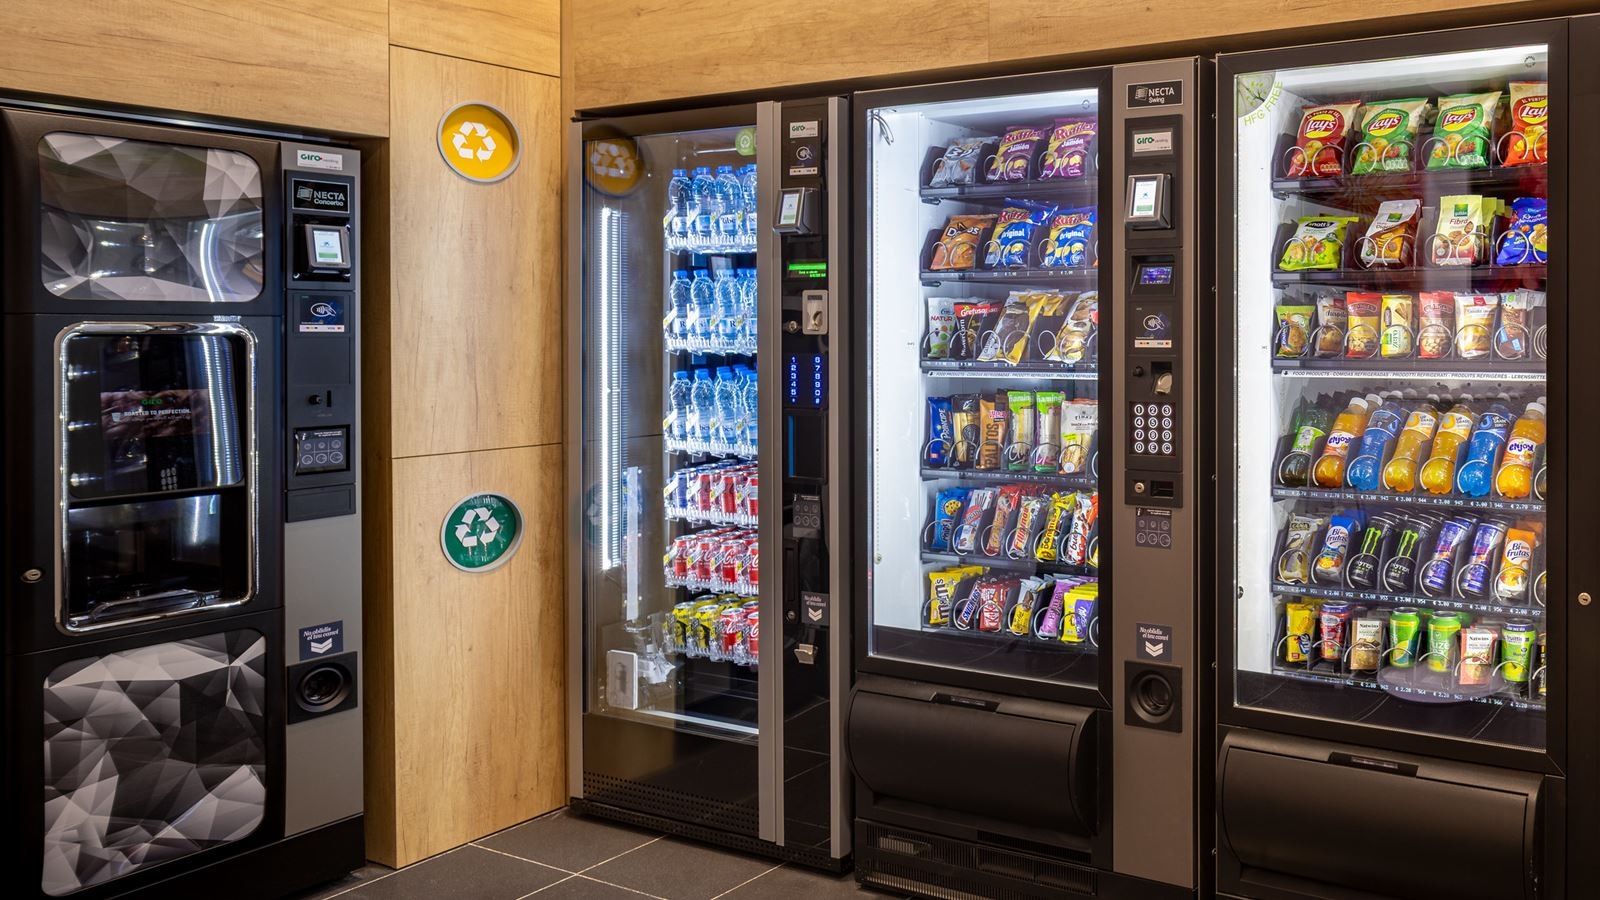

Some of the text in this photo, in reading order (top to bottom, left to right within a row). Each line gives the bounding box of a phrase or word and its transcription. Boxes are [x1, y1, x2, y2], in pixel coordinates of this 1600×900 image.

[1148, 86, 1175, 97] NECTA
[1264, 81, 1283, 113] FREE
[1148, 96, 1165, 104] Swing
[1055, 121, 1096, 140] Ruffles
[313, 191, 345, 201] NECTA
[1508, 442, 1534, 452] enjoy
[1512, 542, 1522, 551] Bi
[1506, 549, 1531, 560] frutas
[962, 587, 981, 621] SNICKERS
